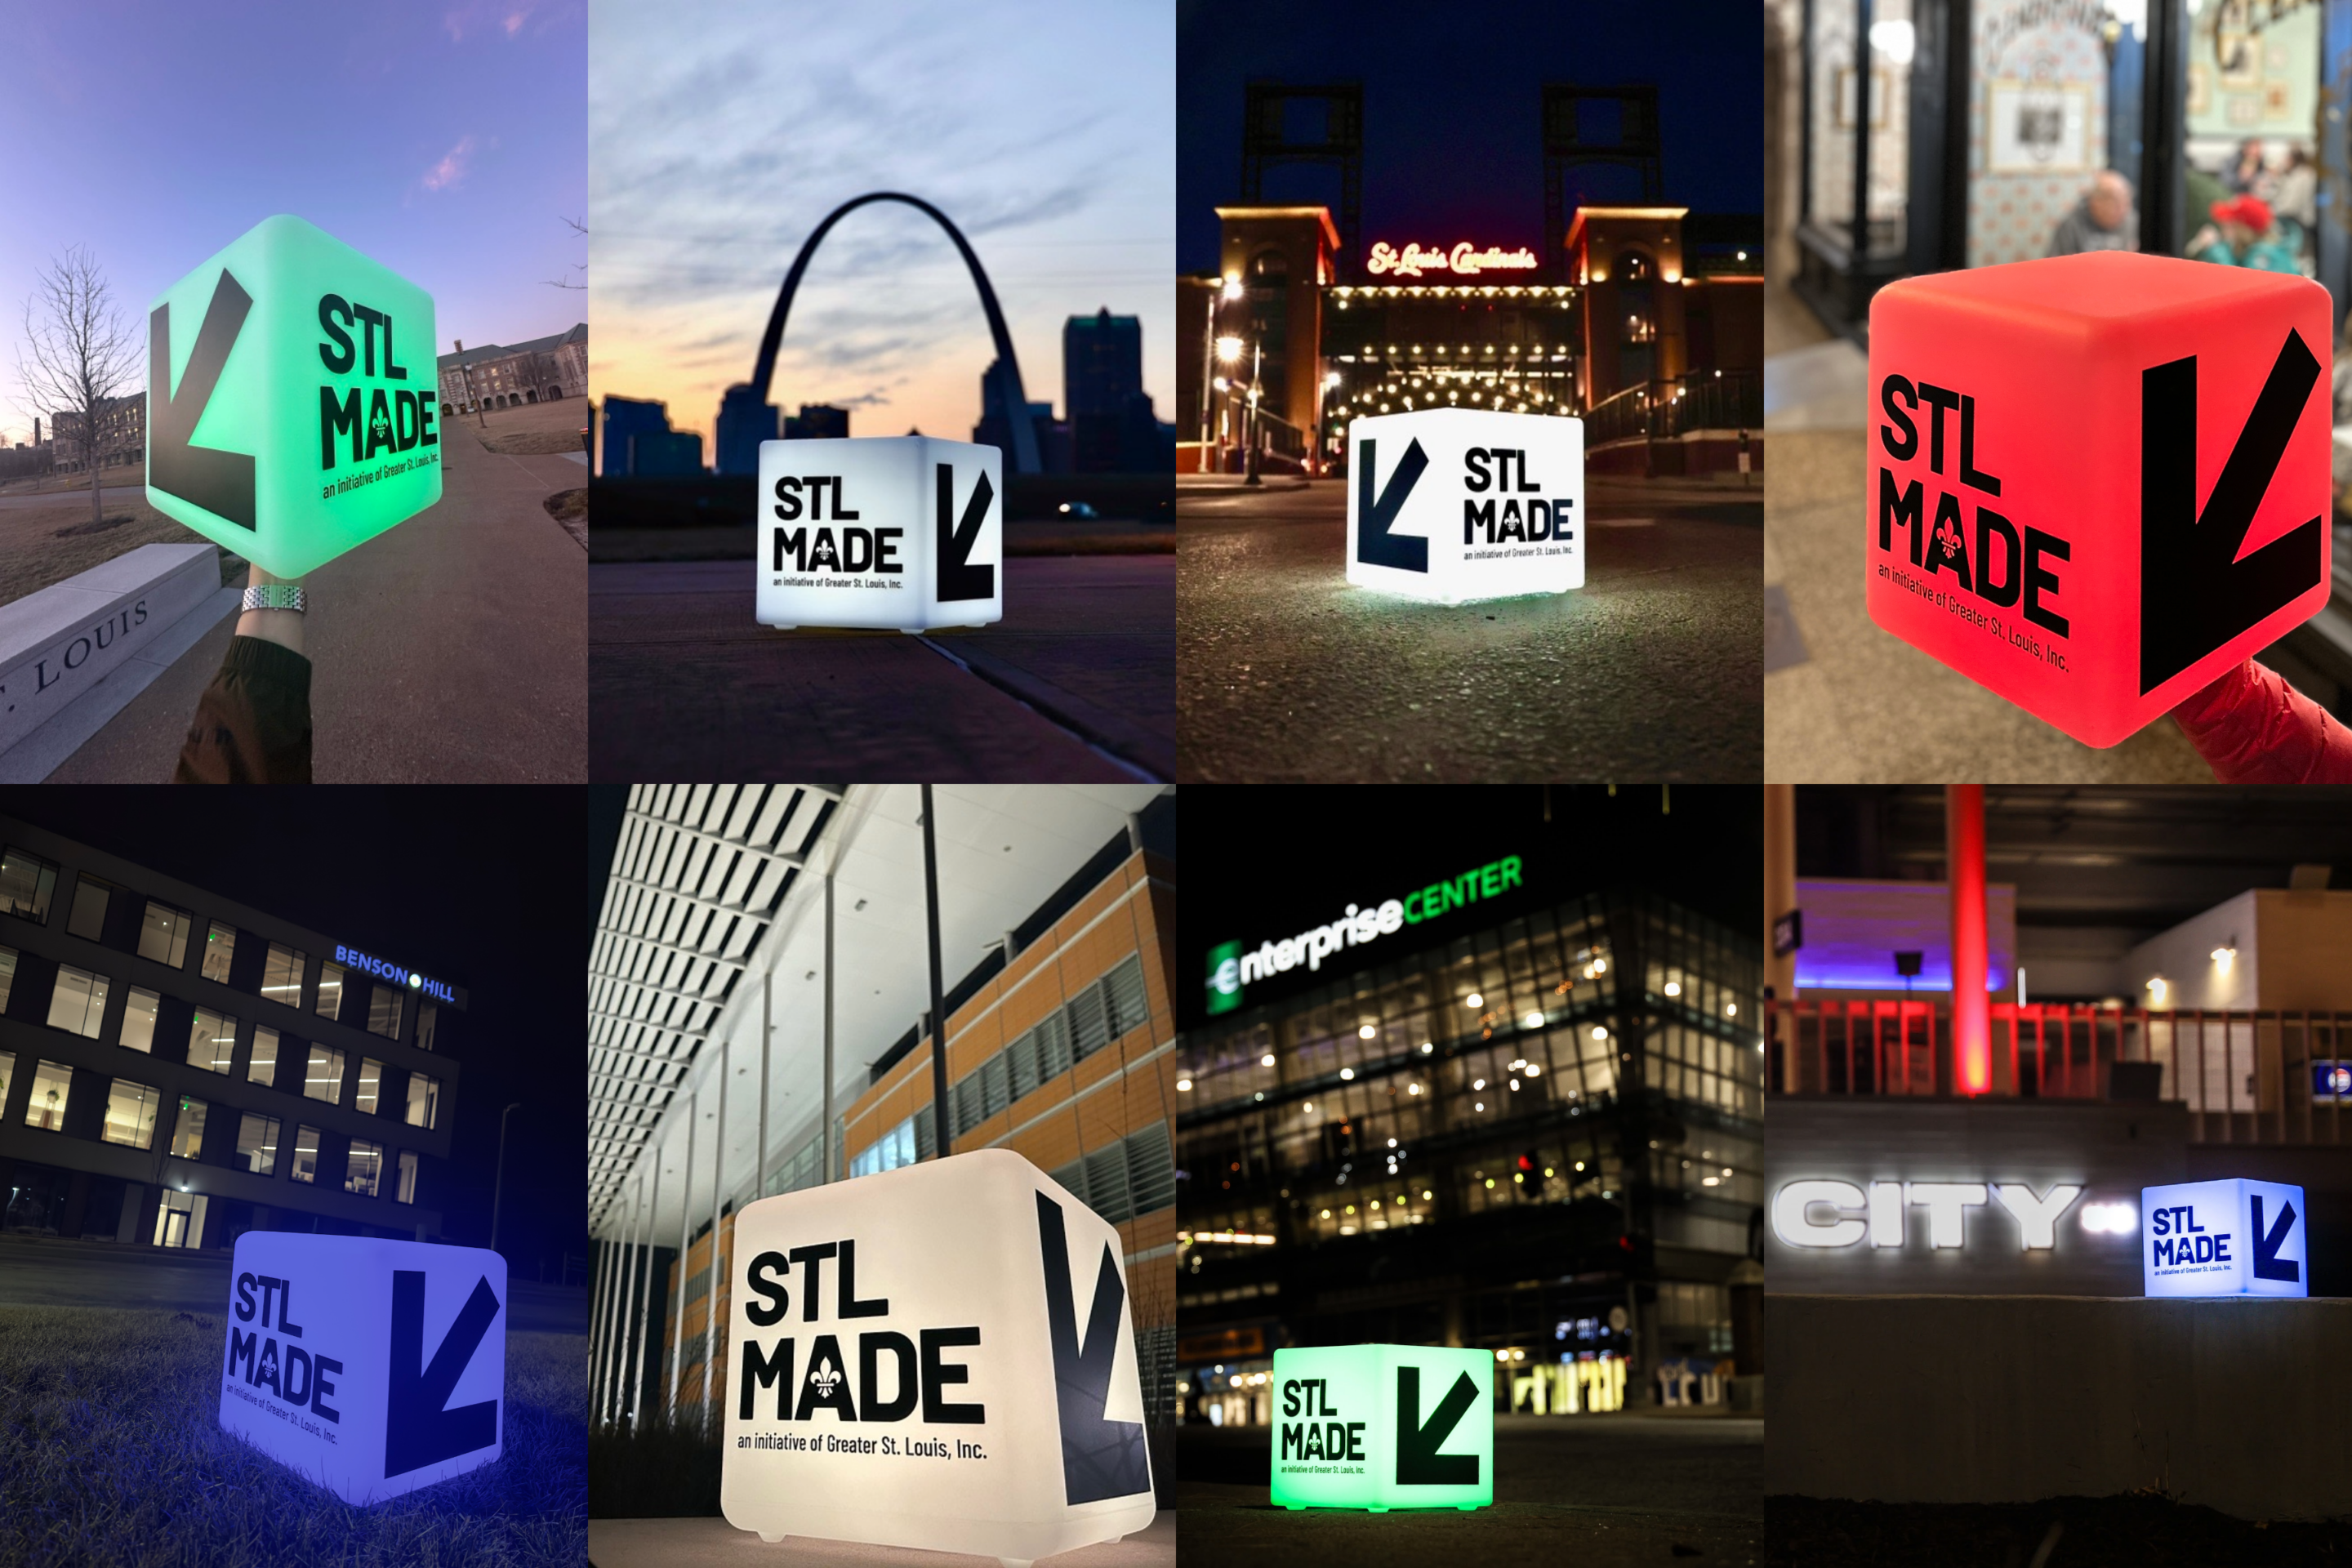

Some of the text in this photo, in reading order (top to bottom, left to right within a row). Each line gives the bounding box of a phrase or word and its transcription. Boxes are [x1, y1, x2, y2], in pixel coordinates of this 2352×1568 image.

[1393, 243, 1449, 277] Louis
[1450, 242, 1538, 274] Cardinals
[318, 293, 408, 381] STL
[319, 385, 439, 471] MADE
[1880, 373, 2001, 497] STL
[323, 484, 335, 499] an
[337, 471, 373, 495] initiative
[376, 466, 382, 481] of
[384, 462, 406, 479] Greater
[774, 476, 859, 521] STL
[1464, 447, 1541, 492] STL
[773, 528, 903, 573] MADE
[1464, 499, 1573, 545] MADE
[773, 577, 902, 589] an initiative of Greater St. Louis, Inc.
[1879, 467, 2069, 639] MADE
[34, 599, 148, 695] LOUIS
[1878, 564, 2069, 672] an initiative of Greater St. Louis, Inc.
[1403, 854, 1522, 924] CENTER
[335, 944, 455, 1002] BENSON HILL
[1771, 1179, 2085, 1250] CITY
[2153, 1205, 2205, 1236] STL
[2154, 1233, 2231, 1267] MADE
[235, 1272, 303, 1338] STL
[745, 1238, 889, 1327] STL
[228, 1326, 343, 1425] MADE
[738, 1325, 986, 1425] MADE
[1282, 1379, 1338, 1418] STL
[227, 1384, 337, 1446] an initiative of Greater St. Louis, Inc.
[1281, 1422, 1365, 1461] MADE
[737, 1432, 987, 1460] an initiative of Greater St. Louis, Inc.
